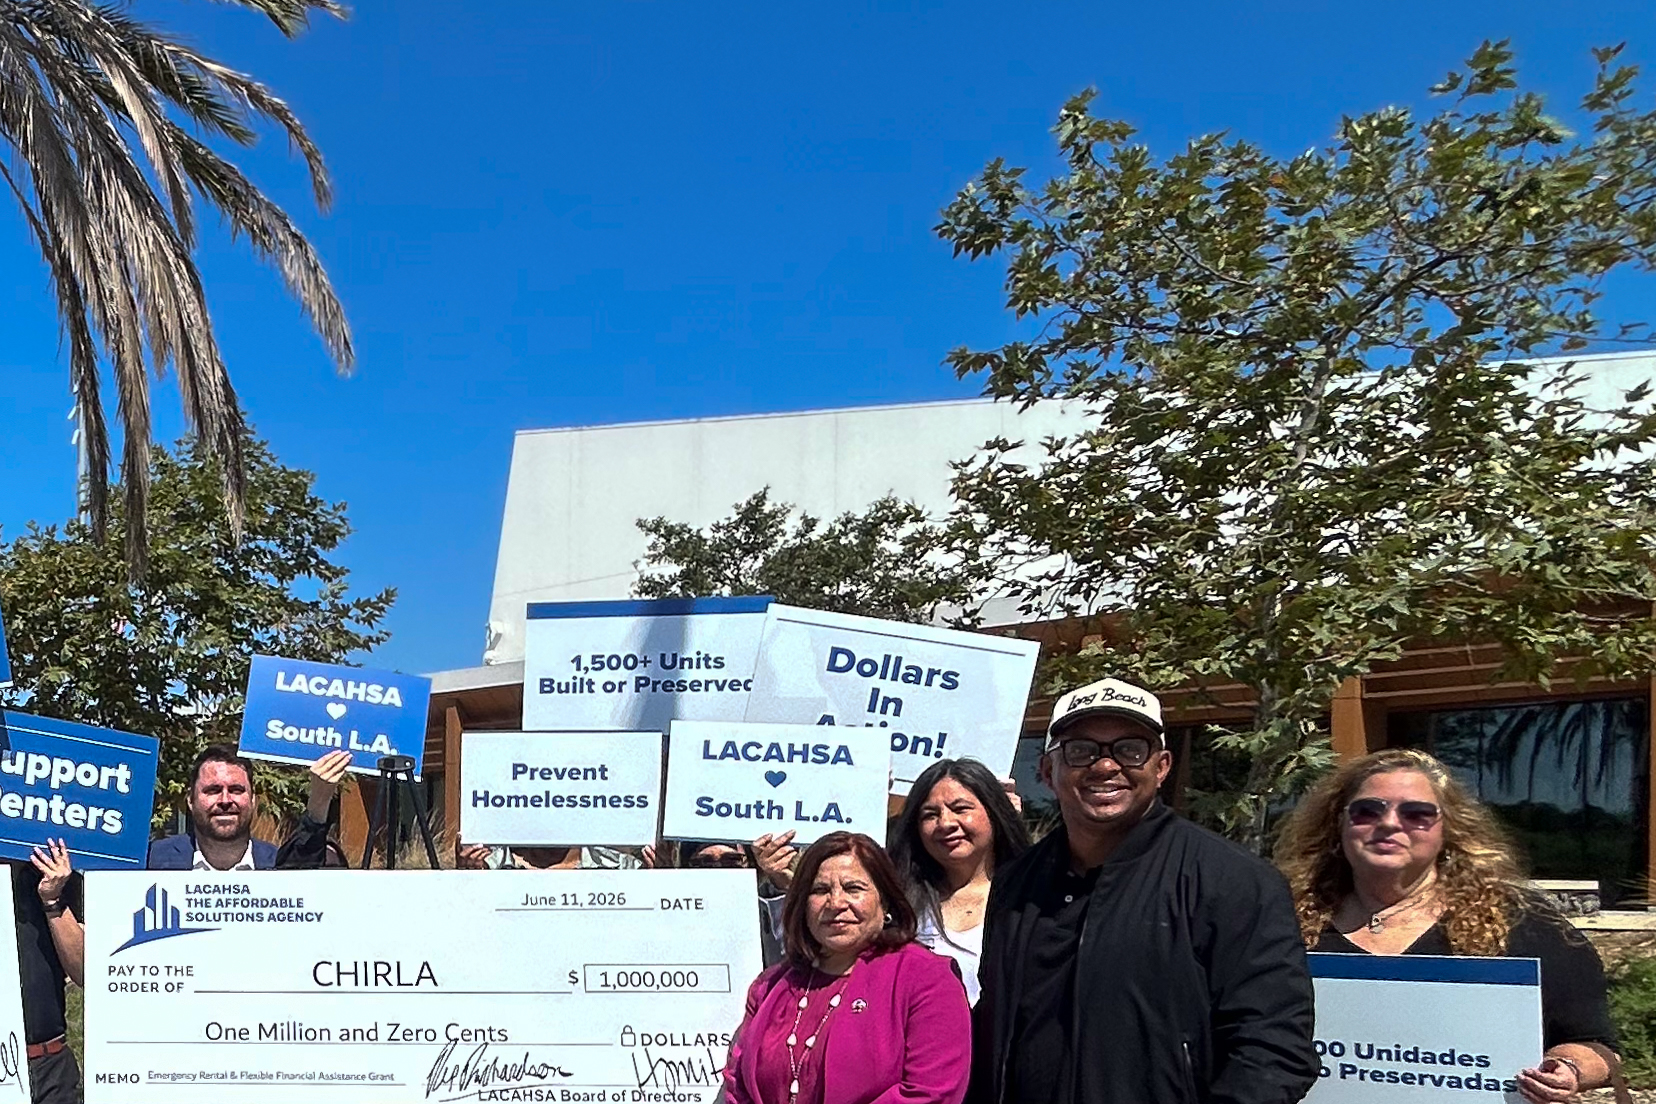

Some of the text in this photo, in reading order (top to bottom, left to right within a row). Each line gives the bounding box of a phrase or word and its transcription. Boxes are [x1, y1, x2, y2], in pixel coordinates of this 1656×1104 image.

[571, 651, 725, 675] 1,500+ Units
[826, 646, 960, 690] Dollars
[275, 671, 402, 708] LACAHSA
[539, 676, 595, 694] Built
[602, 679, 627, 693] or
[867, 687, 904, 717] In
[1067, 687, 1147, 712] Long Beach
[265, 720, 398, 755] South L.A.
[703, 740, 854, 766] LACAHSA
[512, 763, 608, 781] Prevent
[472, 791, 649, 809] Homelessness
[695, 796, 853, 824] South L.A.
[185, 884, 251, 894] LACAHSA
[185, 897, 304, 908] THE AFFORDABLE
[521, 893, 626, 908] June 11, 2026
[661, 898, 704, 910] DATE
[185, 911, 324, 922] SOLUTIONS AGENCY
[108, 965, 194, 977] PAY TO THE
[312, 961, 439, 987] CHIRLA
[568, 970, 699, 990] $ 1,000,000
[108, 982, 185, 993] ORDER OF
[205, 1021, 508, 1043] One Million and Zero Cents
[641, 1033, 731, 1047] DOLLARS
[1354, 1042, 1492, 1069] Unidades
[95, 1071, 395, 1084] MEMO Emergency Rental & Flexible Financial Assistance Grant
[1340, 1063, 1517, 1091] Preservadas
[478, 1089, 701, 1102] LACAHSA Board of Directors
